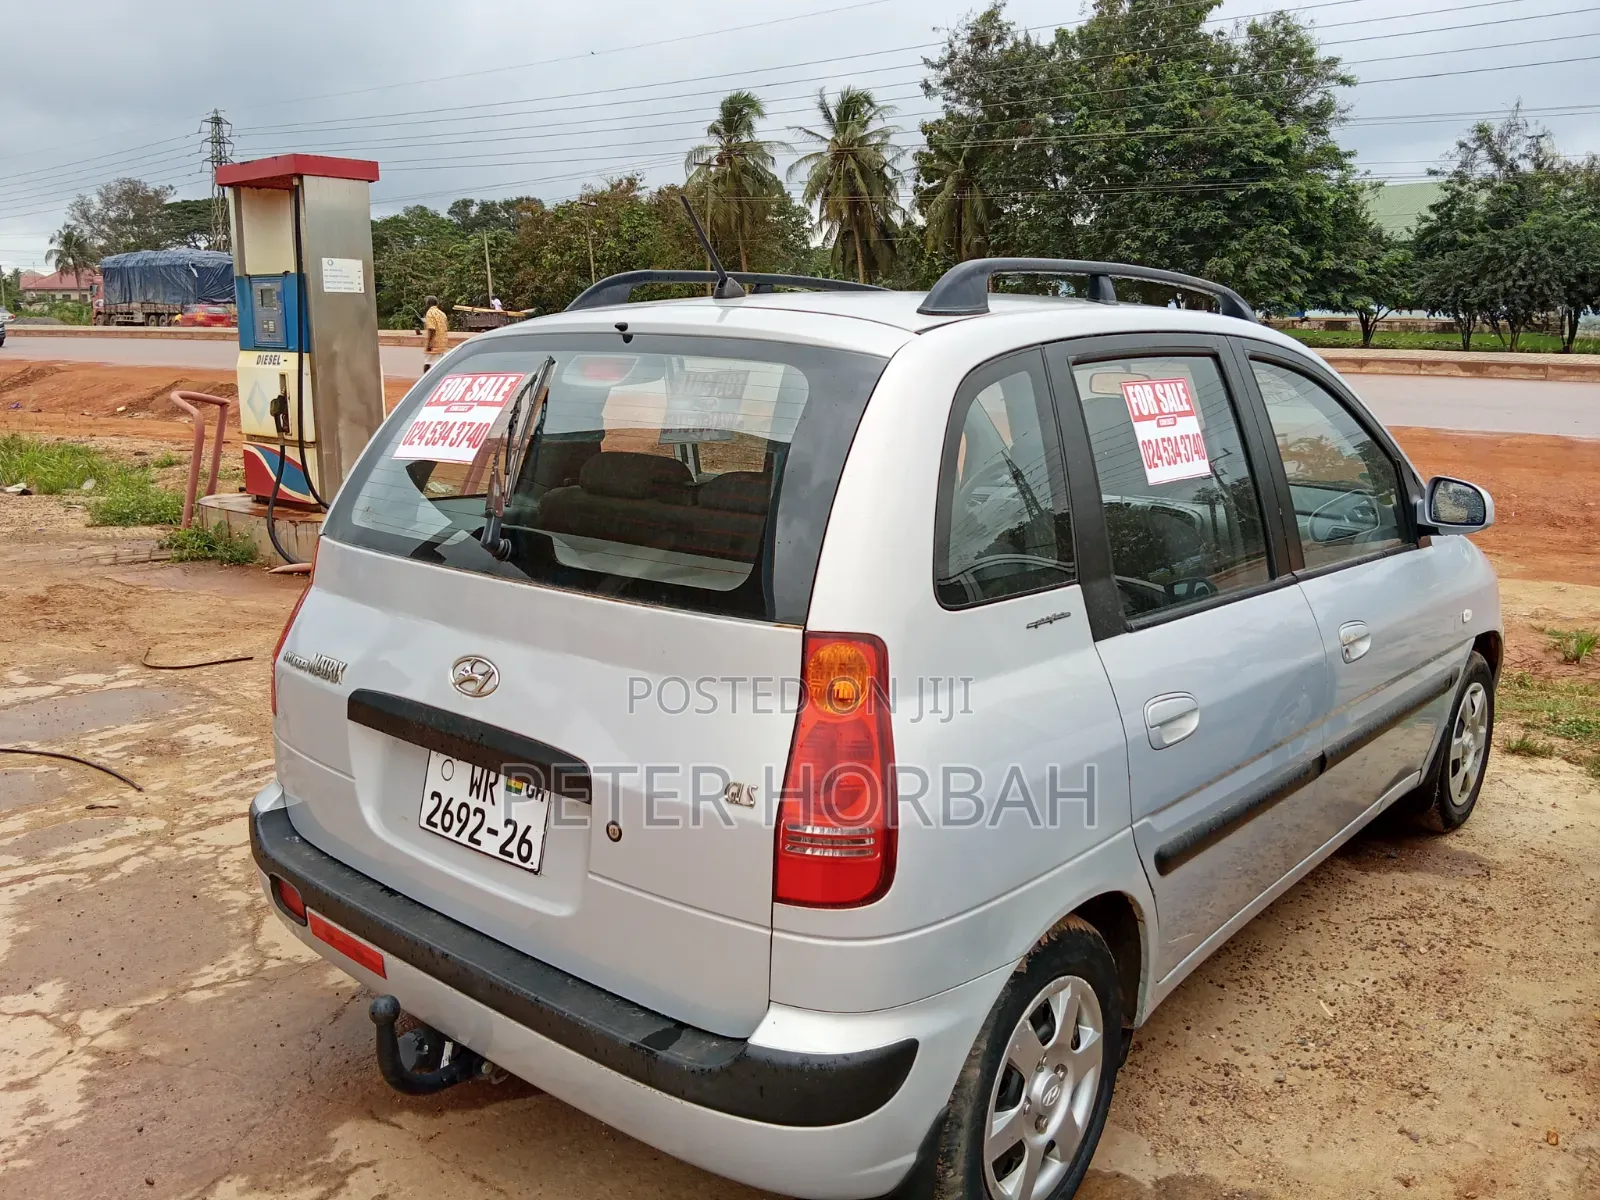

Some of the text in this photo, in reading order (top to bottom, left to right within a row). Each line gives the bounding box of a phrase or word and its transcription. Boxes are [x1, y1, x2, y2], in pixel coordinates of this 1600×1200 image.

[256, 354, 281, 366] DIESEL
[432, 376, 517, 402] FOR SALE
[1126, 382, 1190, 416] FOR SALE
[310, 652, 348, 685] MATRIX
[468, 764, 499, 806] WR
[724, 786, 759, 809] GLS
[426, 791, 533, 864] 2692-26
